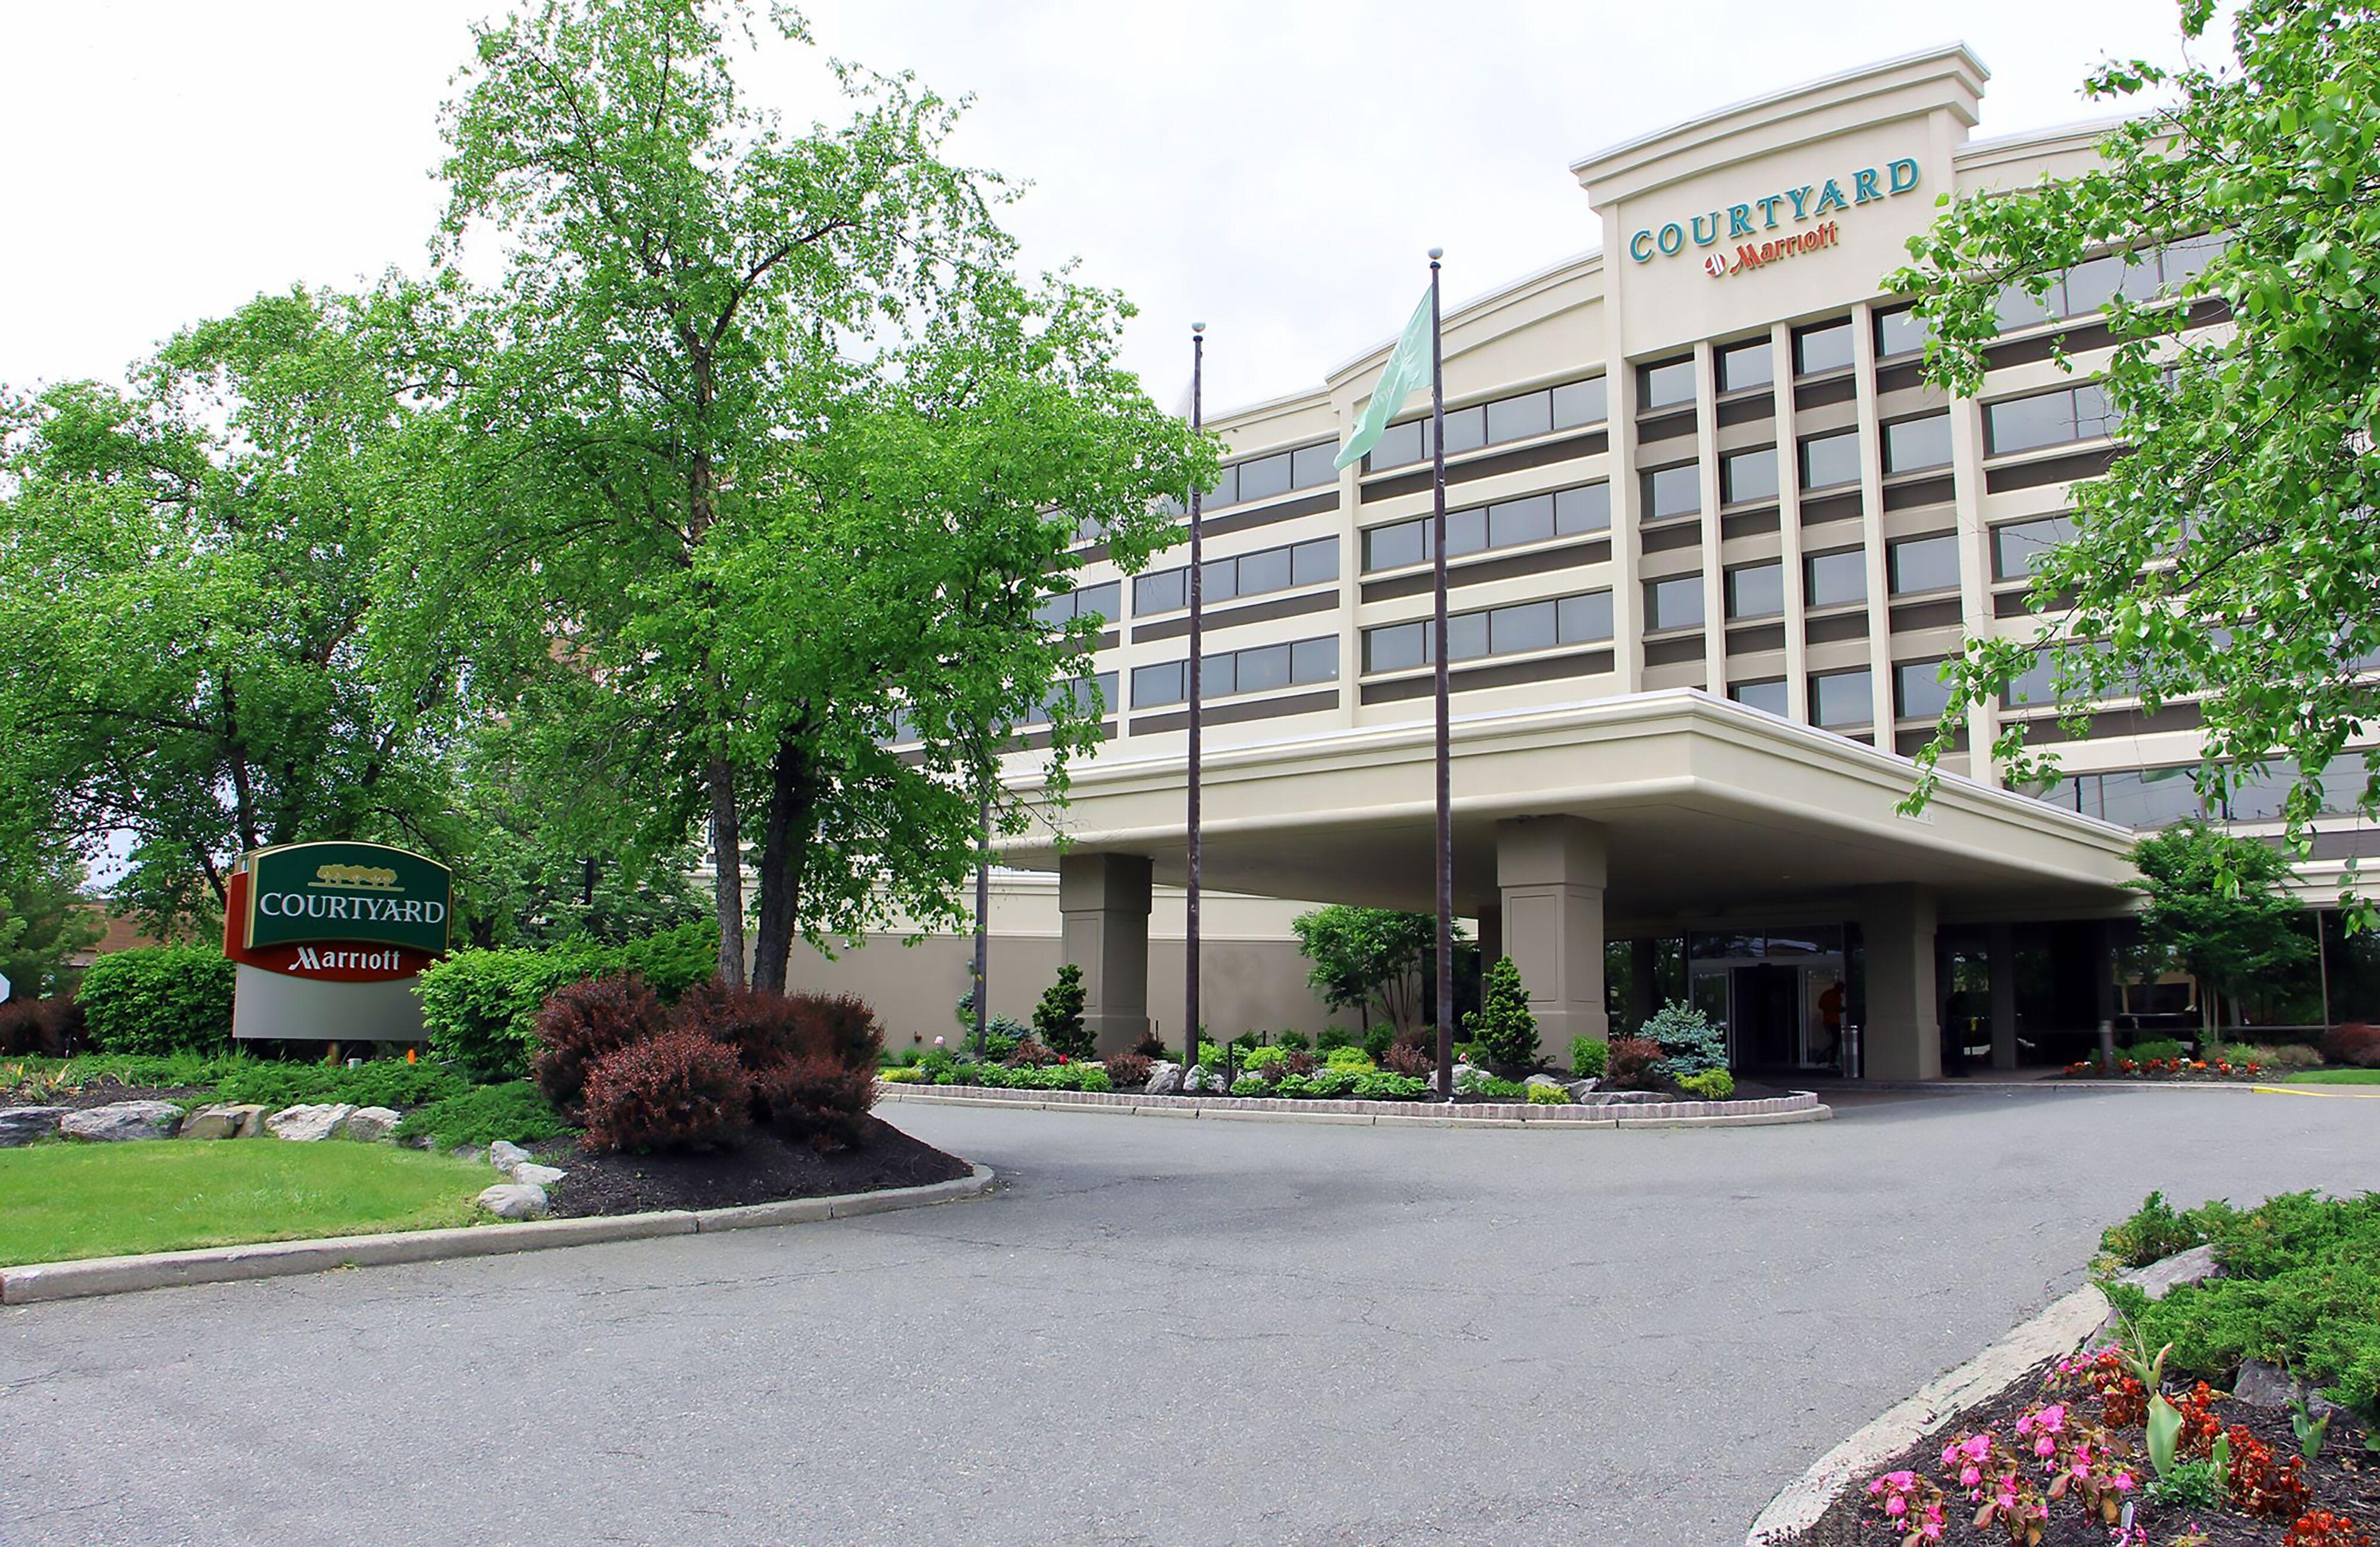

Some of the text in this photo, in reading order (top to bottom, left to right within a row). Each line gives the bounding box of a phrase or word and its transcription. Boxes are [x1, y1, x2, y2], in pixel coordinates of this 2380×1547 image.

[1629, 157, 1921, 264] COURTYARD
[1728, 221, 1839, 275] Marriott
[259, 892, 445, 923] COURTYARD
[288, 945, 400, 971] Marriott
